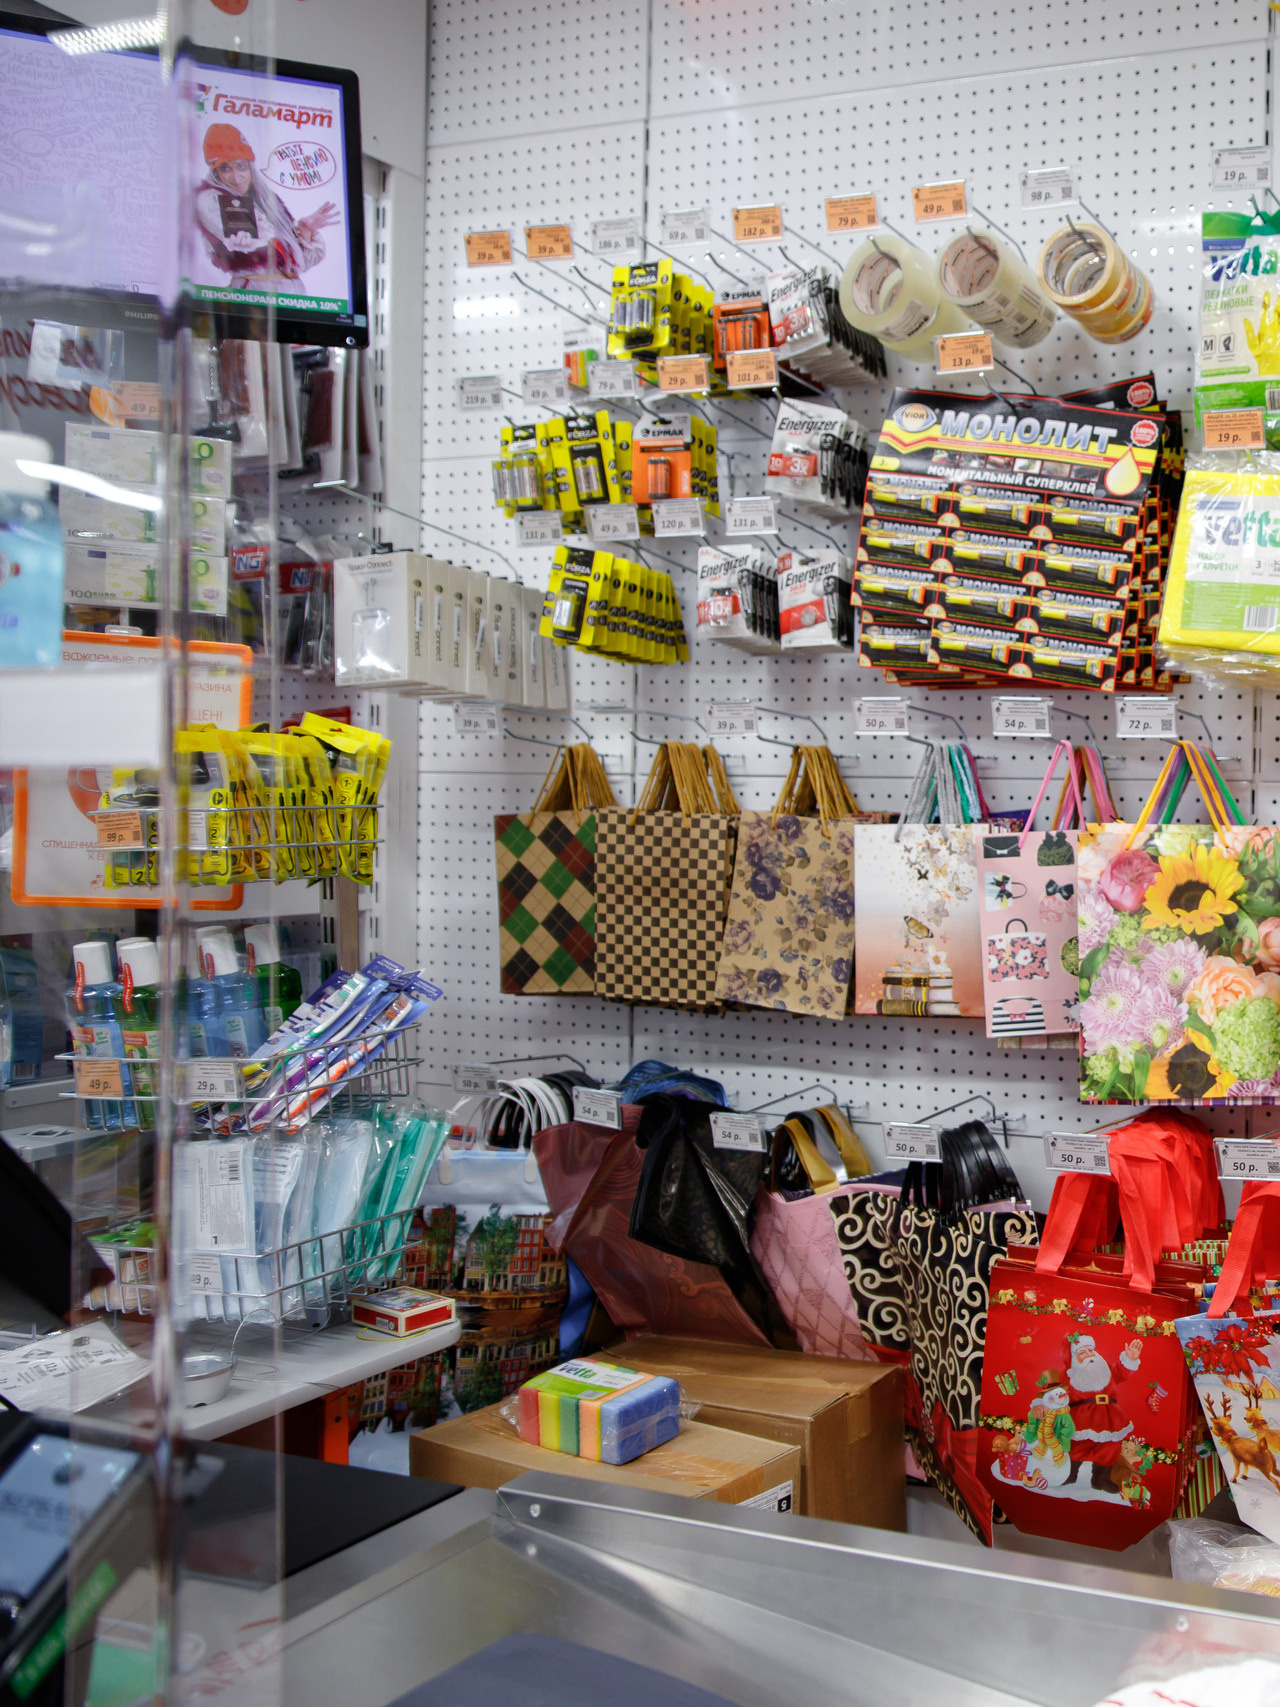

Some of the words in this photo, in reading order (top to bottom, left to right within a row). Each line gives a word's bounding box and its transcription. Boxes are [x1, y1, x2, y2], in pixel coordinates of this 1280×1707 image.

[213, 94, 332, 129] Галамарт
[274, 145, 302, 160] ТРАТЬТЕ
[291, 148, 328, 171] ПЕНСИЮ
[1224, 170, 1236, 181] 19
[1238, 172, 1247, 182] р.
[922, 204, 934, 214] 49
[936, 205, 944, 214] р.
[771, 265, 818, 302] Energizer
[202, 289, 276, 305] ПЕНСИОНЕРАМ
[278, 296, 317, 309] СКИДКА
[778, 417, 838, 432] Energizer
[940, 410, 1118, 452] МОНОЛИТ
[928, 466, 1023, 486] МОМЕНТАЛЬНЫЙ
[1026, 476, 1095, 494] СУПЕРКЛЕЙ
[1068, 499, 1133, 517] МОНОЛИТ
[971, 533, 1033, 550] МОНОЛИТ
[1062, 546, 1127, 563] МОНОЛИТ
[700, 553, 749, 580] Energizer
[786, 561, 836, 590] Energizer
[963, 579, 1026, 597] МОНОЛИТ
[197, 1081, 208, 1090] 29
[209, 1083, 217, 1092] р.
[1233, 1162, 1246, 1171] 50
[1248, 1164, 1258, 1173] р.
[558, 1364, 597, 1379] vetta
